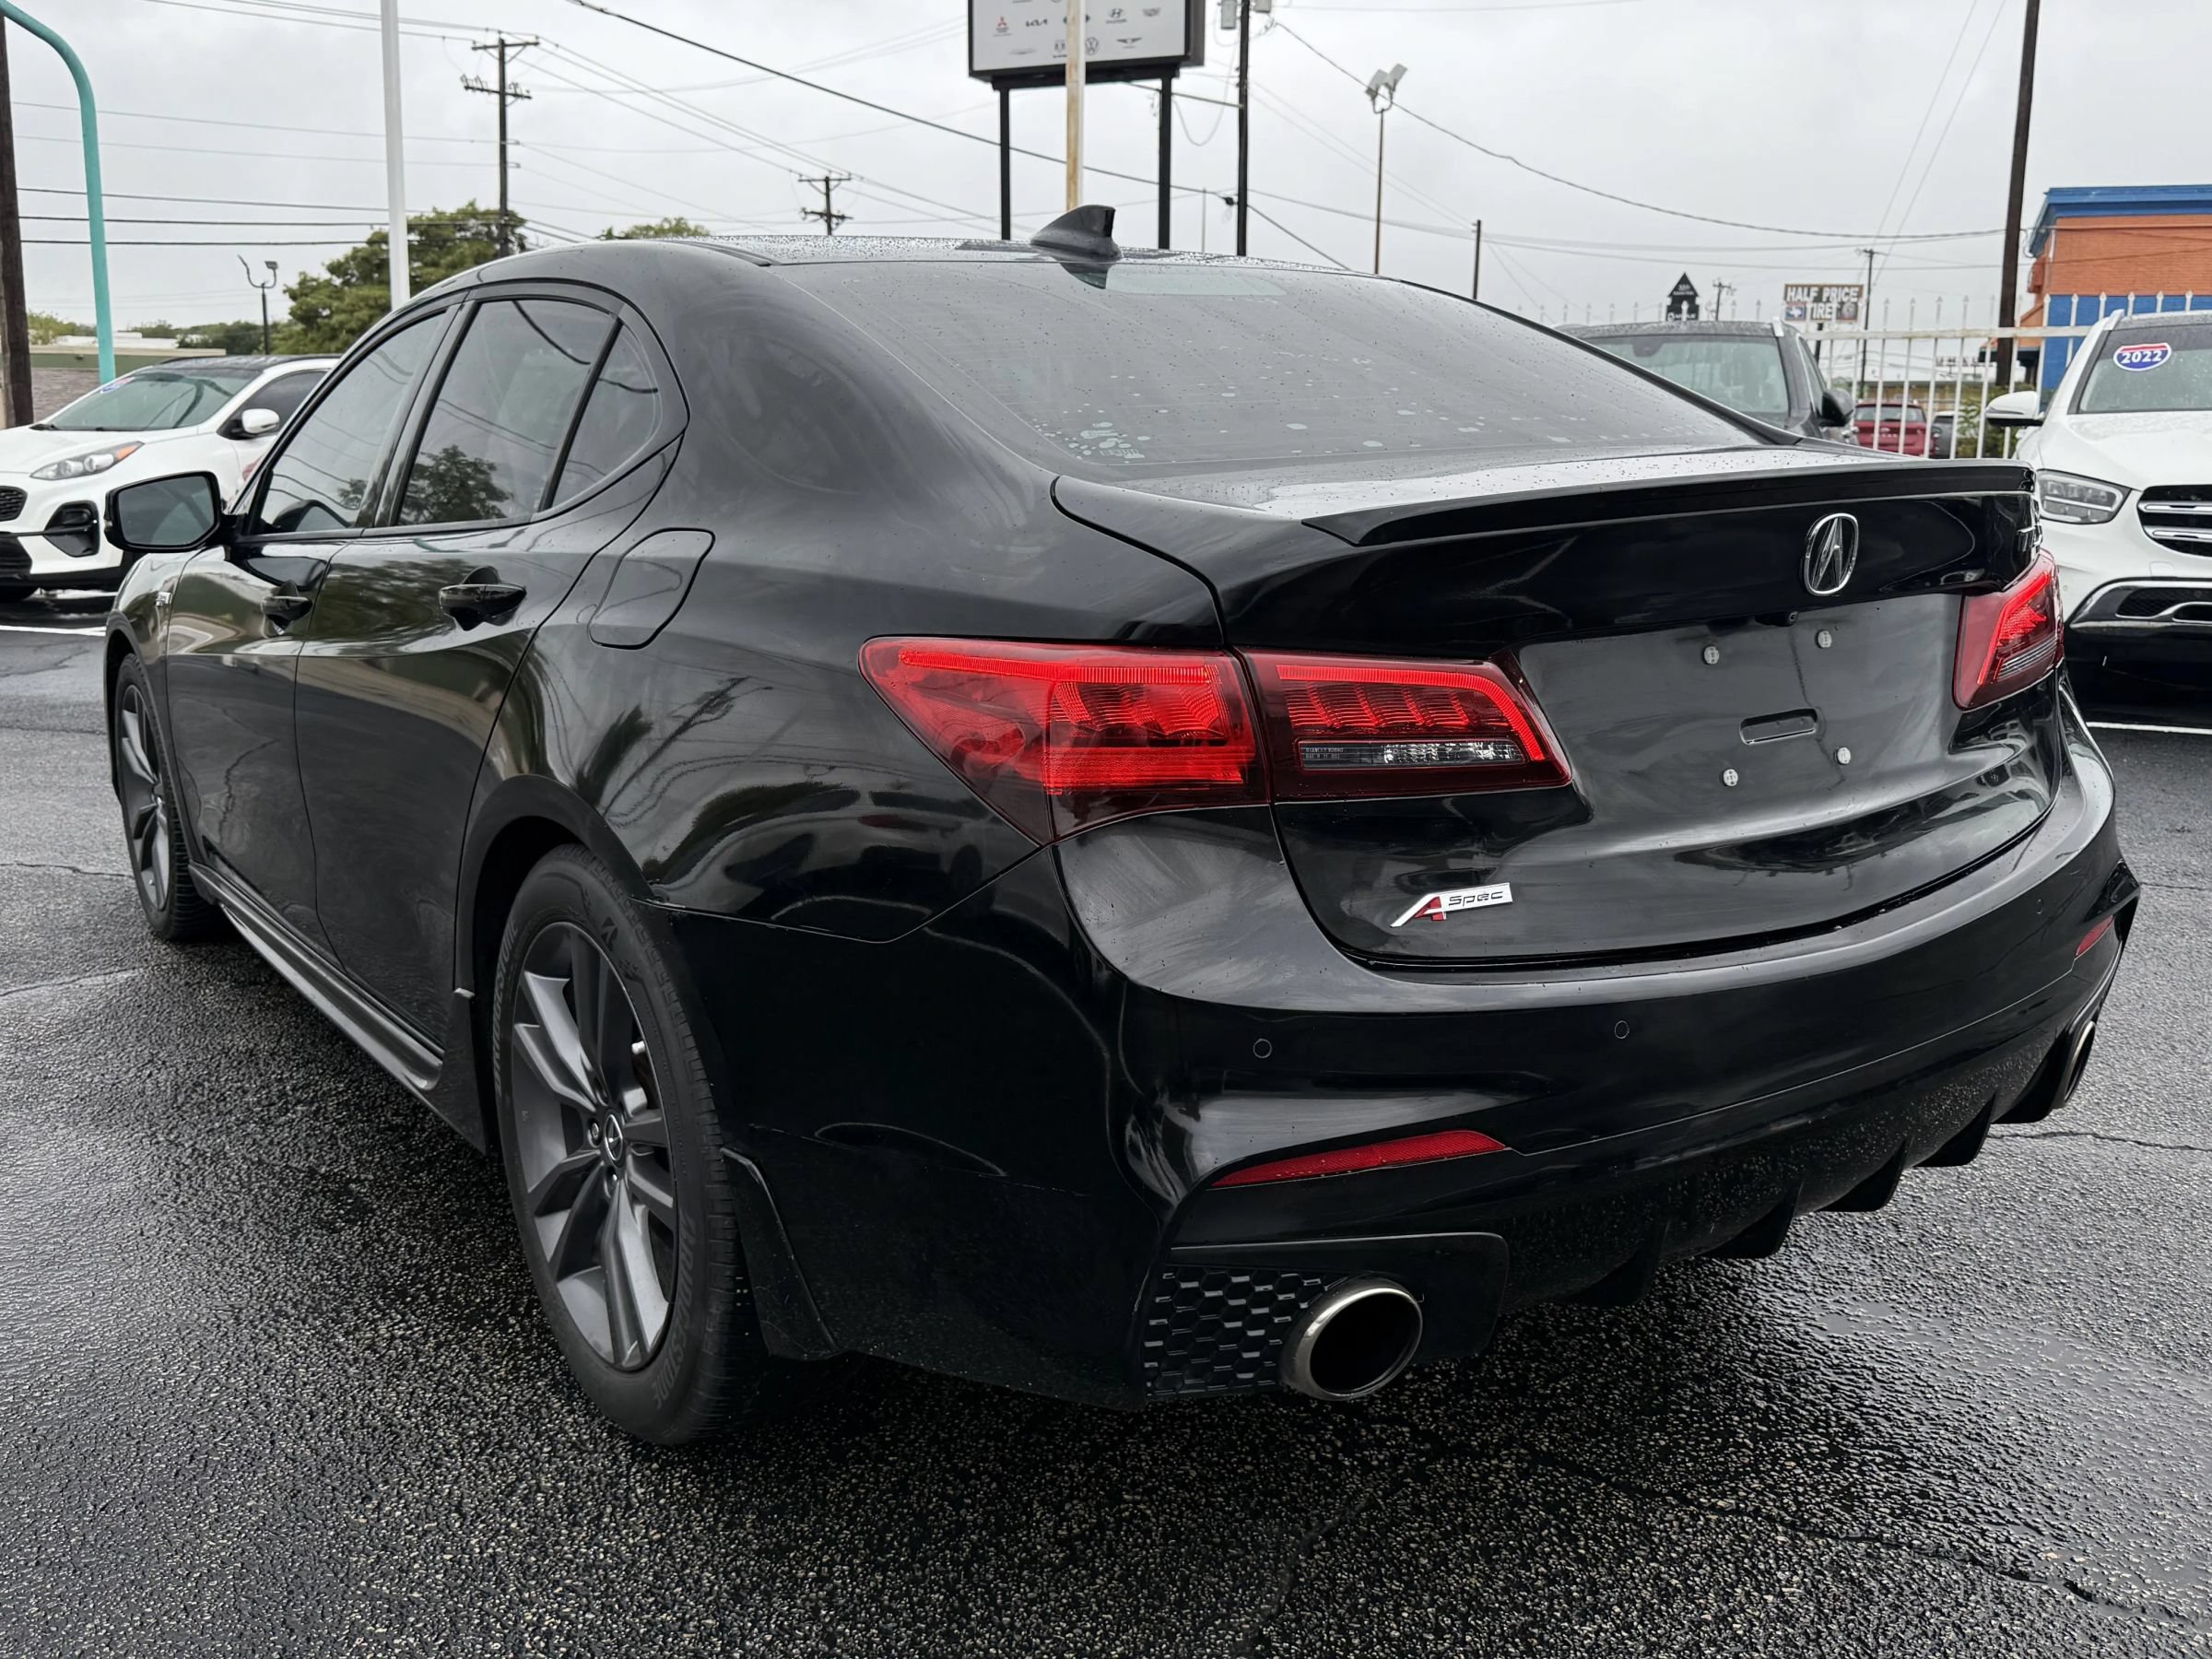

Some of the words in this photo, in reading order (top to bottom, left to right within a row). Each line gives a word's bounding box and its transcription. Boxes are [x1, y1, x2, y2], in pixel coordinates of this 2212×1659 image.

[1786, 287, 1818, 301] HALF
[1822, 287, 1859, 302] PRICE
[2120, 350, 2163, 364] 2022
